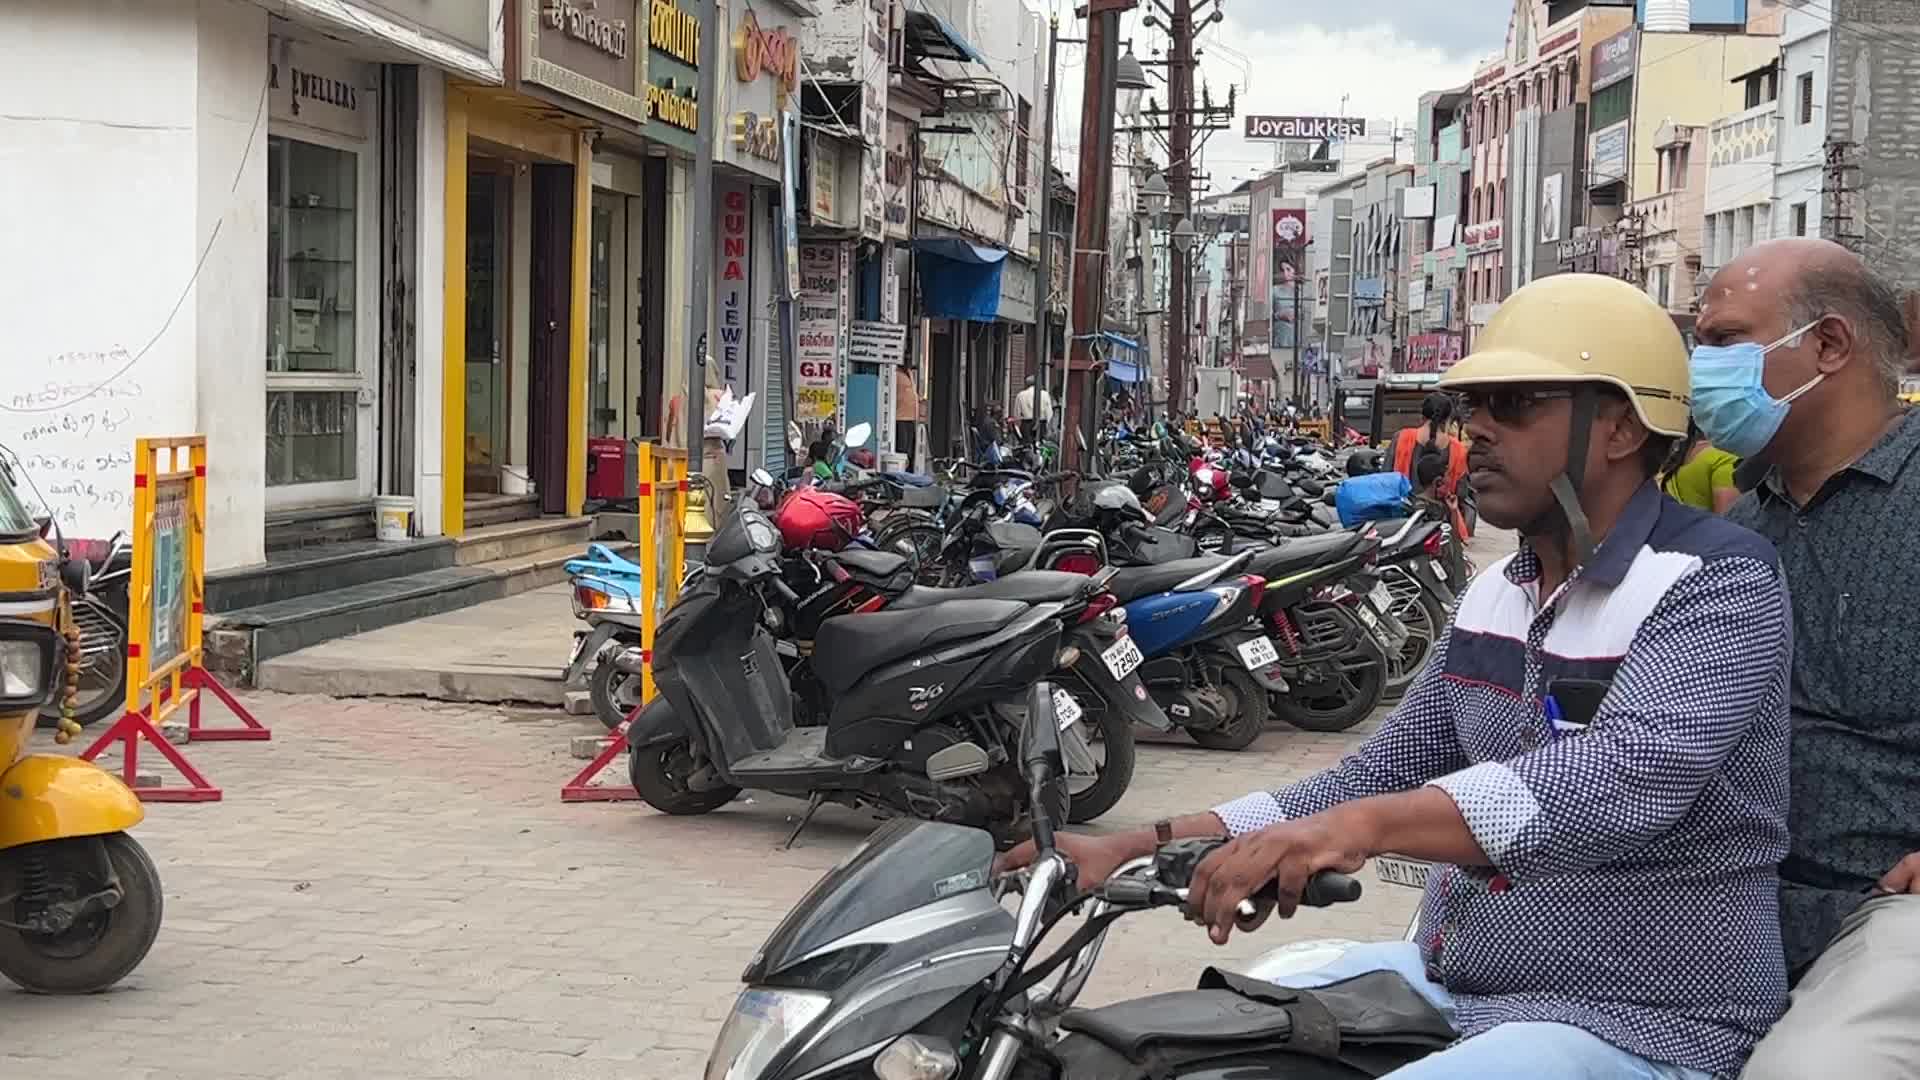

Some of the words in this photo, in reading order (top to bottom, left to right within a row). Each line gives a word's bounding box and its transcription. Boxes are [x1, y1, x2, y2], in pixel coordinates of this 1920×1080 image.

[1249, 118, 1361, 137] Joyalukkas
[723, 191, 745, 280] GUNA
[1113, 648, 1140, 677] 7290
